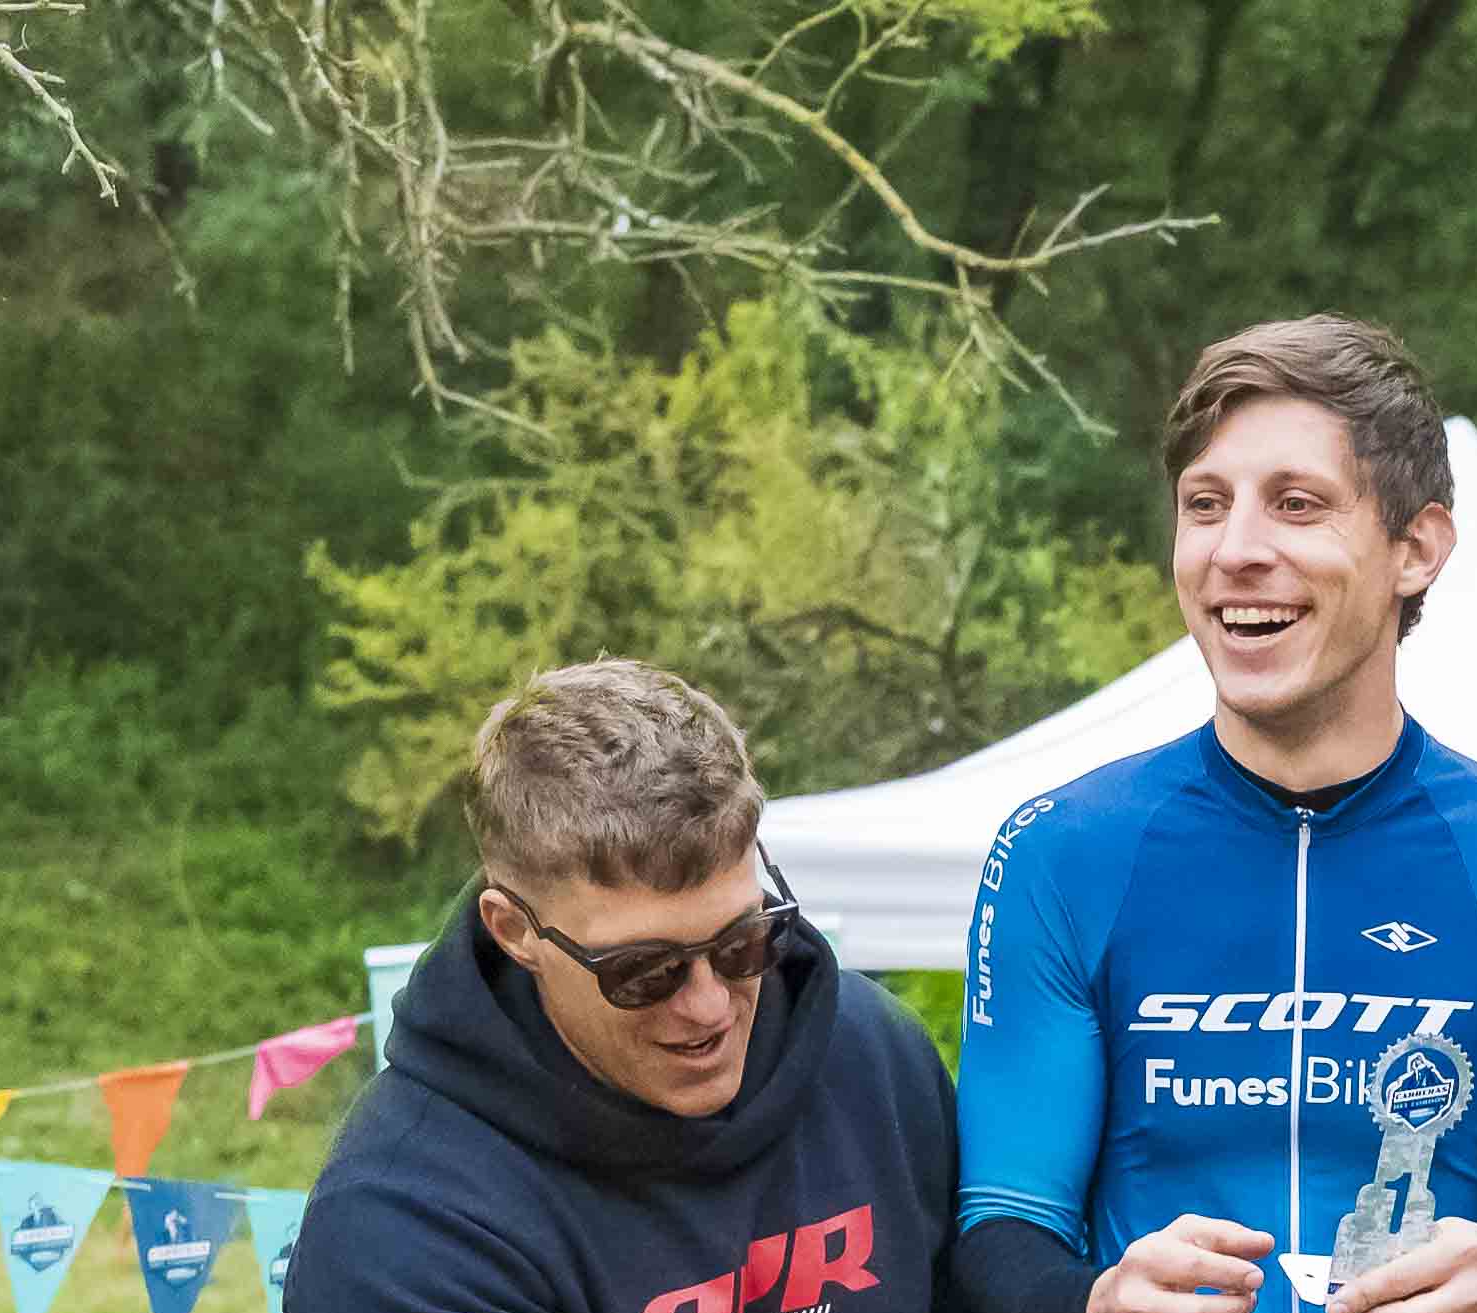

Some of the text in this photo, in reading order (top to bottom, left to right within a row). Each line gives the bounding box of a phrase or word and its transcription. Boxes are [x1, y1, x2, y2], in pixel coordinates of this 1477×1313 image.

[973, 797, 1055, 1027] Funes Bikes
[1128, 992, 1474, 1034] SCOTT
[1145, 1057, 1372, 1106] Funes Bik
[1385, 1172, 1413, 1234] 1
